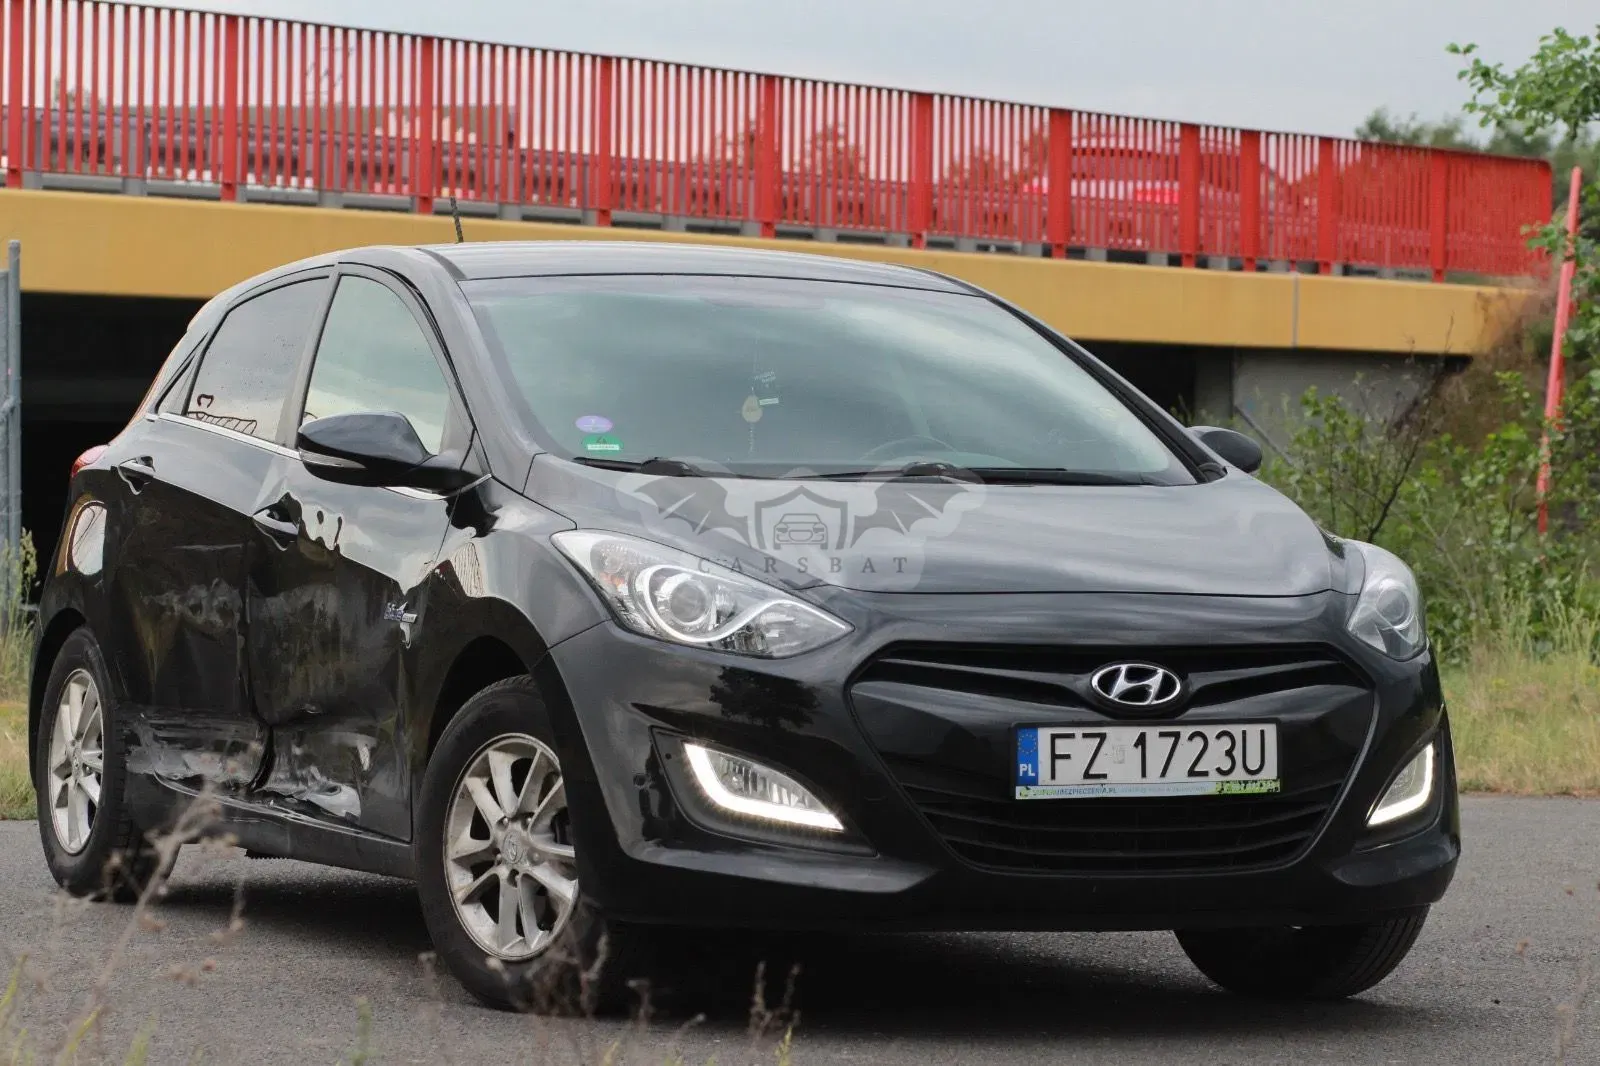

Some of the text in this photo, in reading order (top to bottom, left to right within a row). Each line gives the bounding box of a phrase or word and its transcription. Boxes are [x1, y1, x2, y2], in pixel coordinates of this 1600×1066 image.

[1019, 763, 1036, 777] PL
[1050, 729, 1266, 780] FZ 1723U
